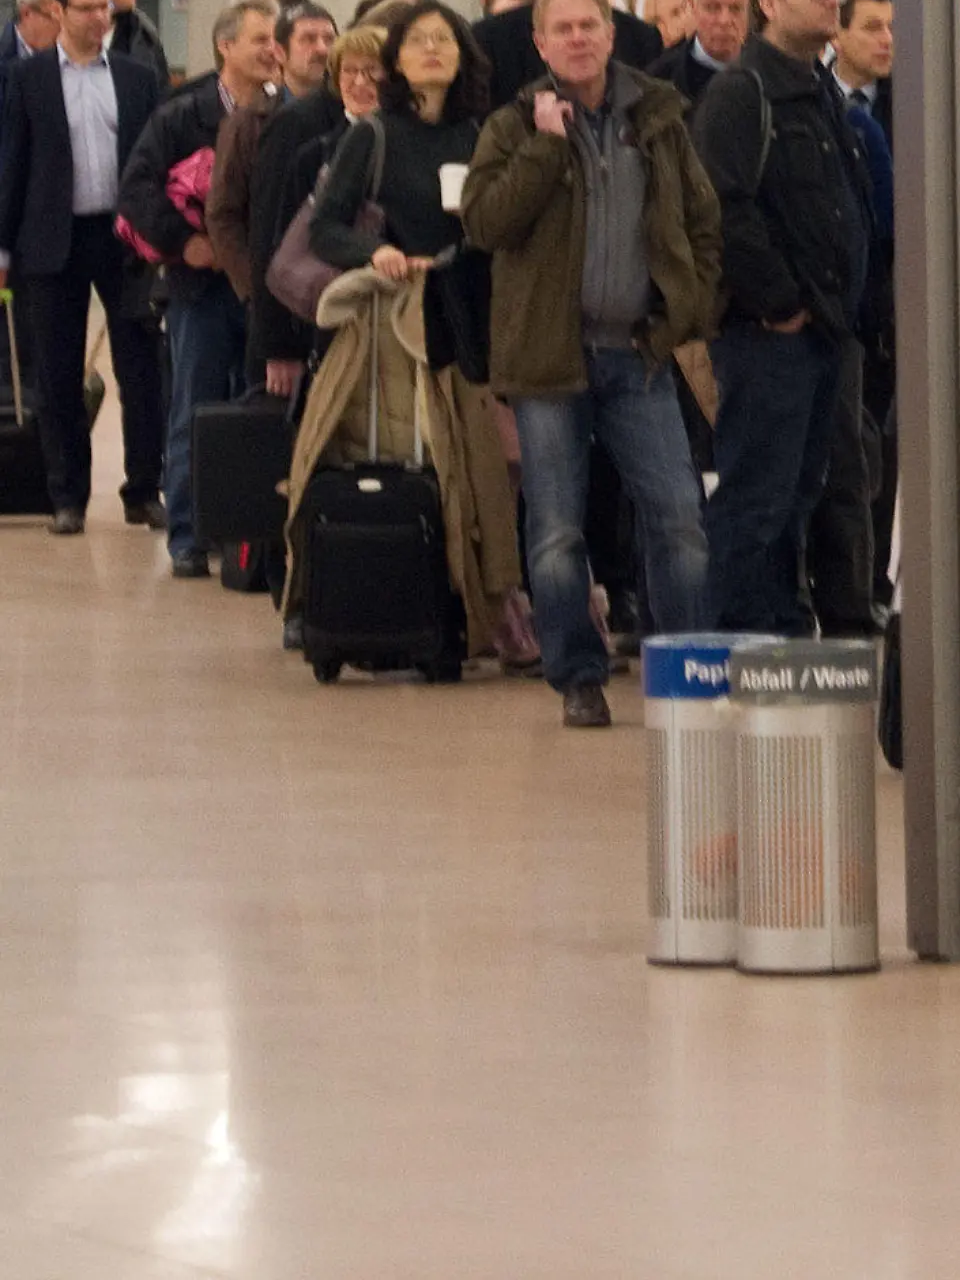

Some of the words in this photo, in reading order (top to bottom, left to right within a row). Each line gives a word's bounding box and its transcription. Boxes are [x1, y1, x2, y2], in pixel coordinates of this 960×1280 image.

[740, 667, 793, 691] Abfall
[800, 668, 810, 692] /
[812, 667, 870, 690] Waste
